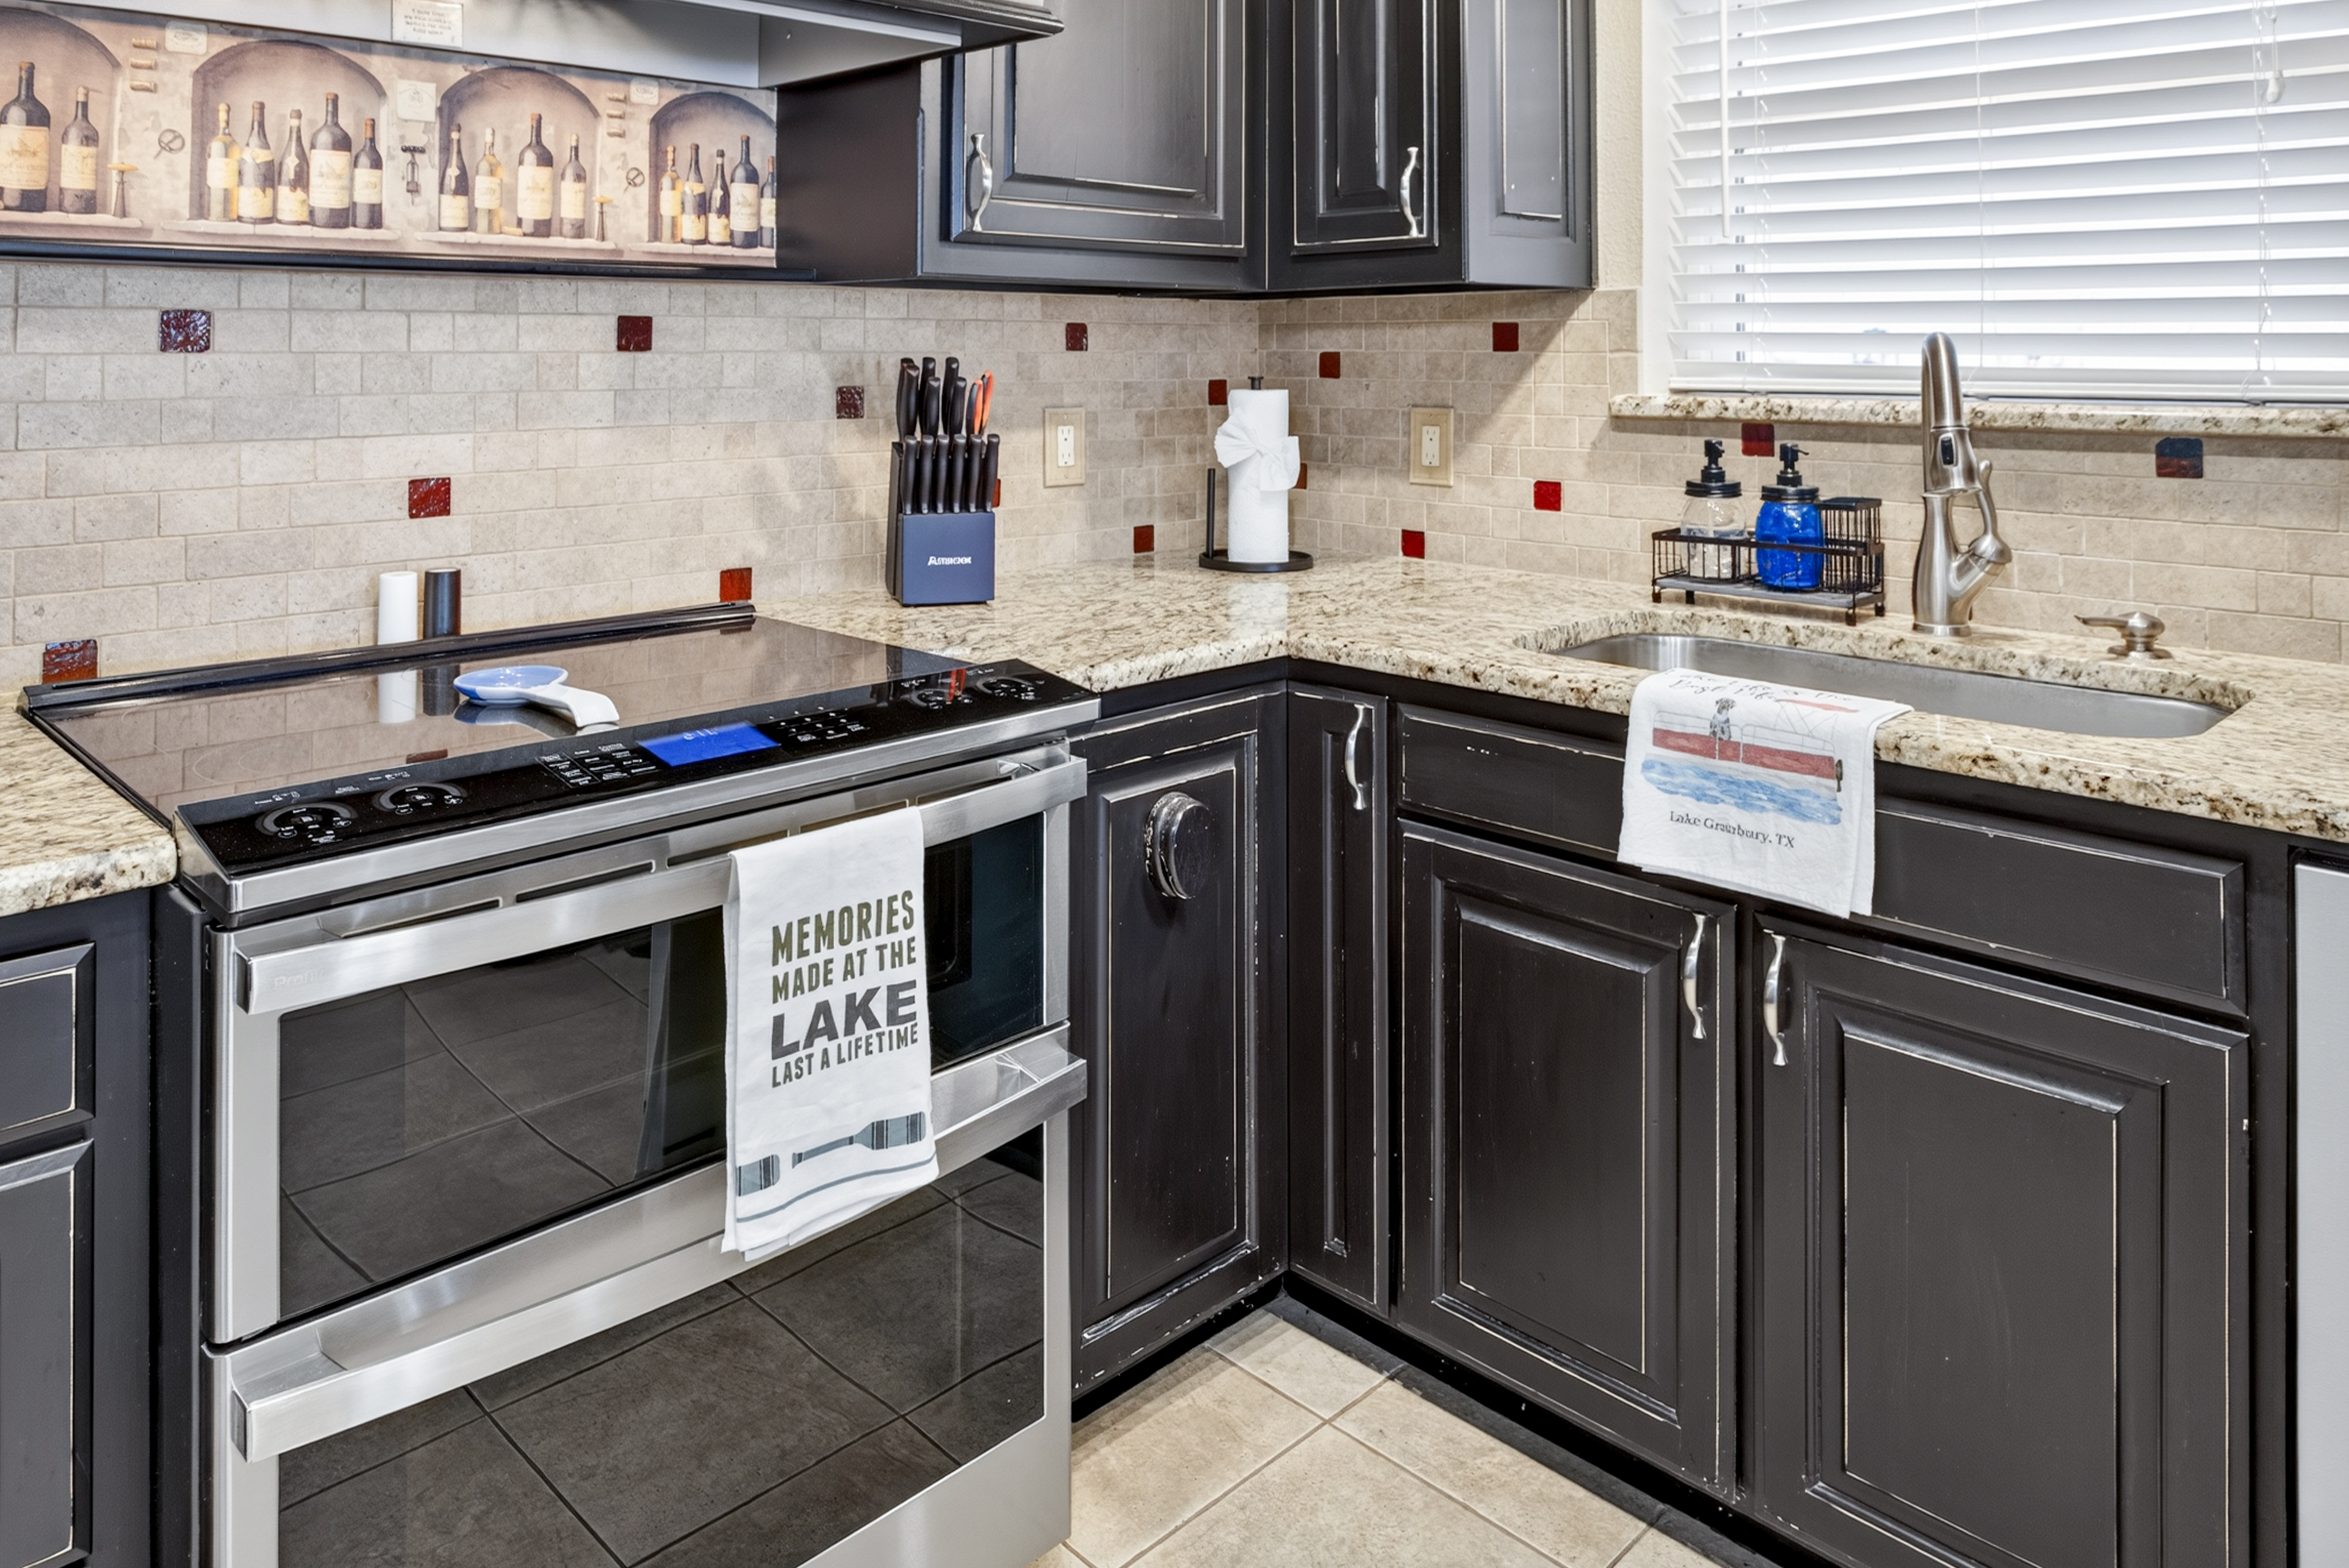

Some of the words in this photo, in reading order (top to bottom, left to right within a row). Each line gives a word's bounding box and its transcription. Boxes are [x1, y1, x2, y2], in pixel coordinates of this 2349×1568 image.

[1669, 810, 1701, 826] Lake
[1775, 833, 1796, 848] TX
[772, 890, 914, 967] MEMORIES
[772, 957, 834, 1004] MADE
[842, 948, 868, 981] AT
[875, 935, 916, 972] THE
[771, 979, 917, 1061] LAKE
[771, 1052, 814, 1089] LAST
[820, 1047, 830, 1071] A
[837, 1021, 918, 1065] LIFETIME
